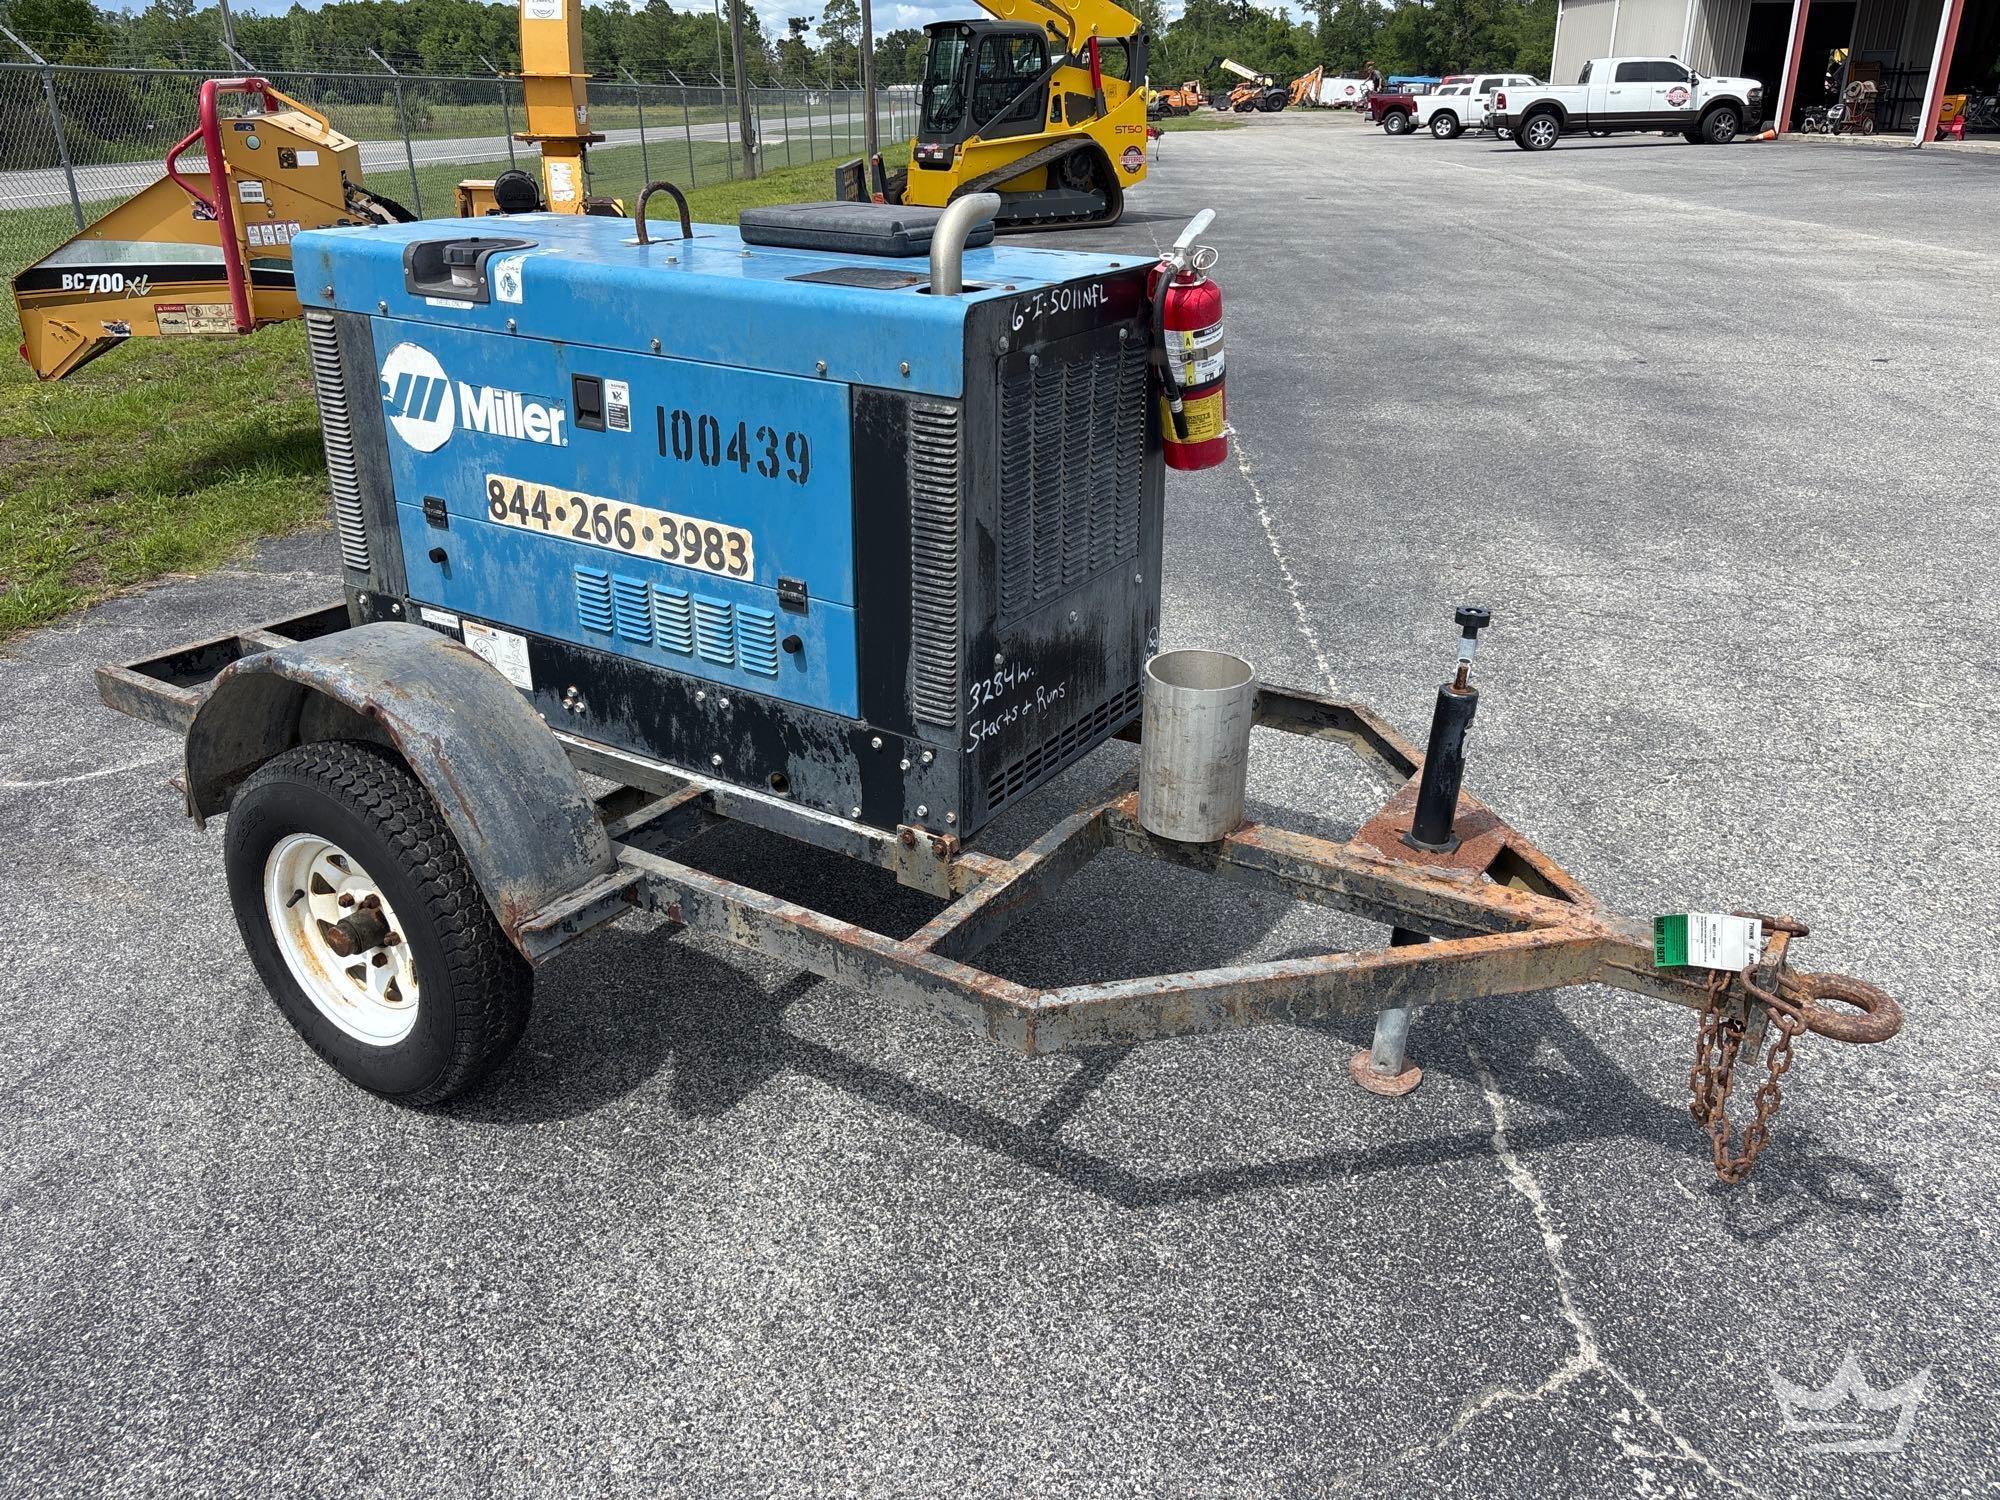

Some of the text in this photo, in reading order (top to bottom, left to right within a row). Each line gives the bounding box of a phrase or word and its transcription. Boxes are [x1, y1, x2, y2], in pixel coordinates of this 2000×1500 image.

[1114, 125, 1143, 134] ST50
[458, 381, 566, 446] Miller
[656, 405, 810, 487] 100439
[966, 704, 1018, 754] Starts
[1036, 681, 1066, 714] Runs
[1656, 936, 1665, 945] TO
[1656, 946, 1665, 964] RENT
